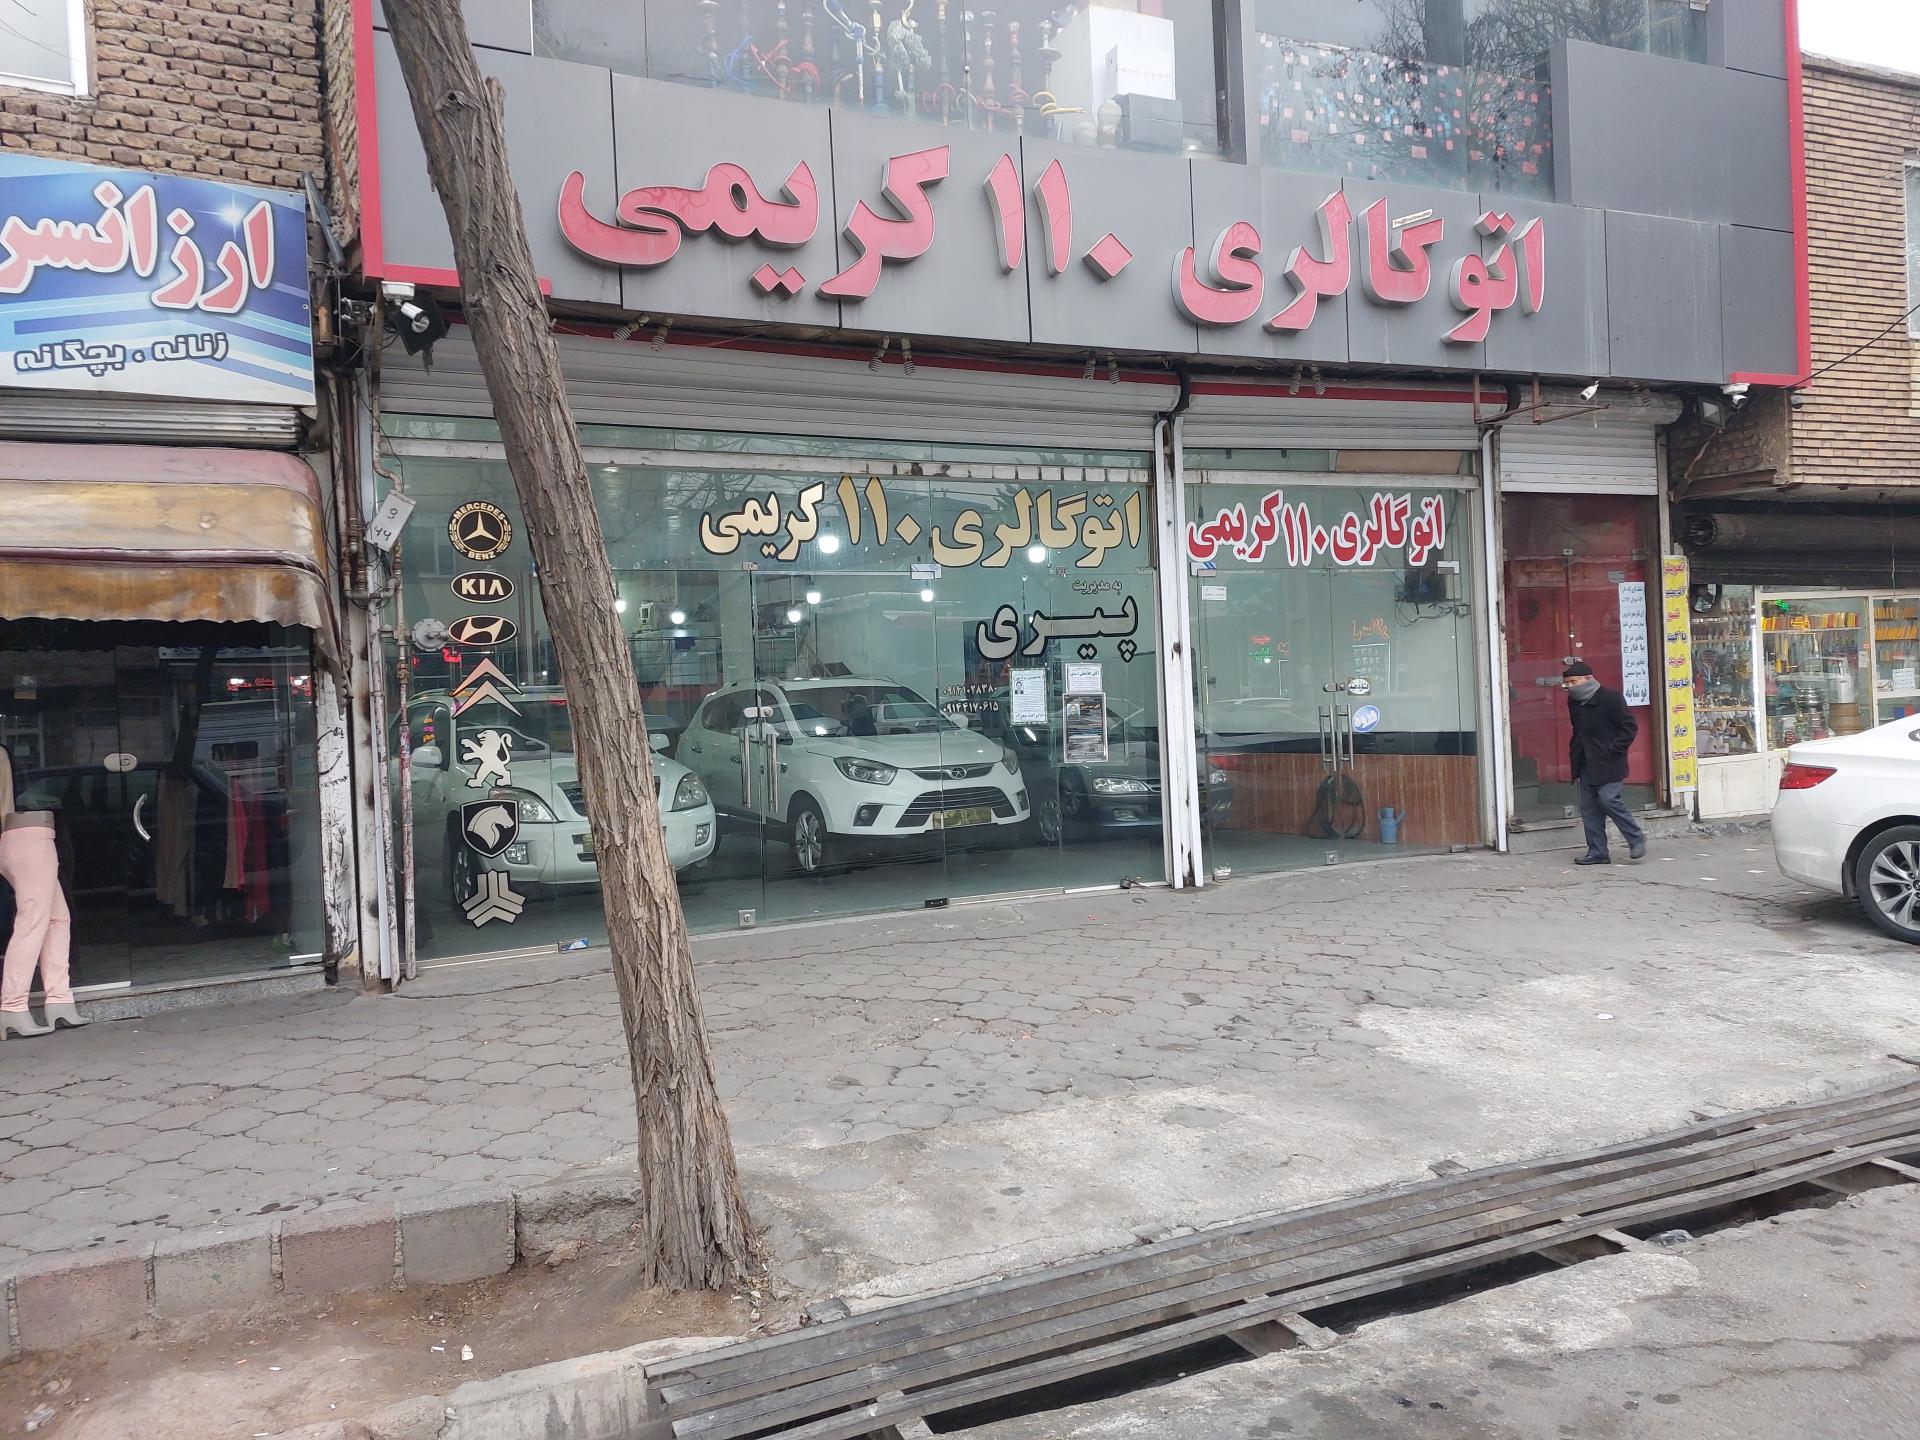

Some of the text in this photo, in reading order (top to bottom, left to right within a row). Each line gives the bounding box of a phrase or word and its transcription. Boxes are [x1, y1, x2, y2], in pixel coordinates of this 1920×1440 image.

[558, 144, 951, 301] کریمی
[14, 339, 126, 377] بچگانه
[151, 332, 229, 362] زنانه
[454, 502, 506, 520] MERCEDES
[699, 481, 825, 562] کریمی
[1186, 489, 1284, 562] کریمی
[467, 551, 496, 561] BENZ
[461, 578, 505, 596] KIA
[1071, 580, 1111, 595] مدیریت
